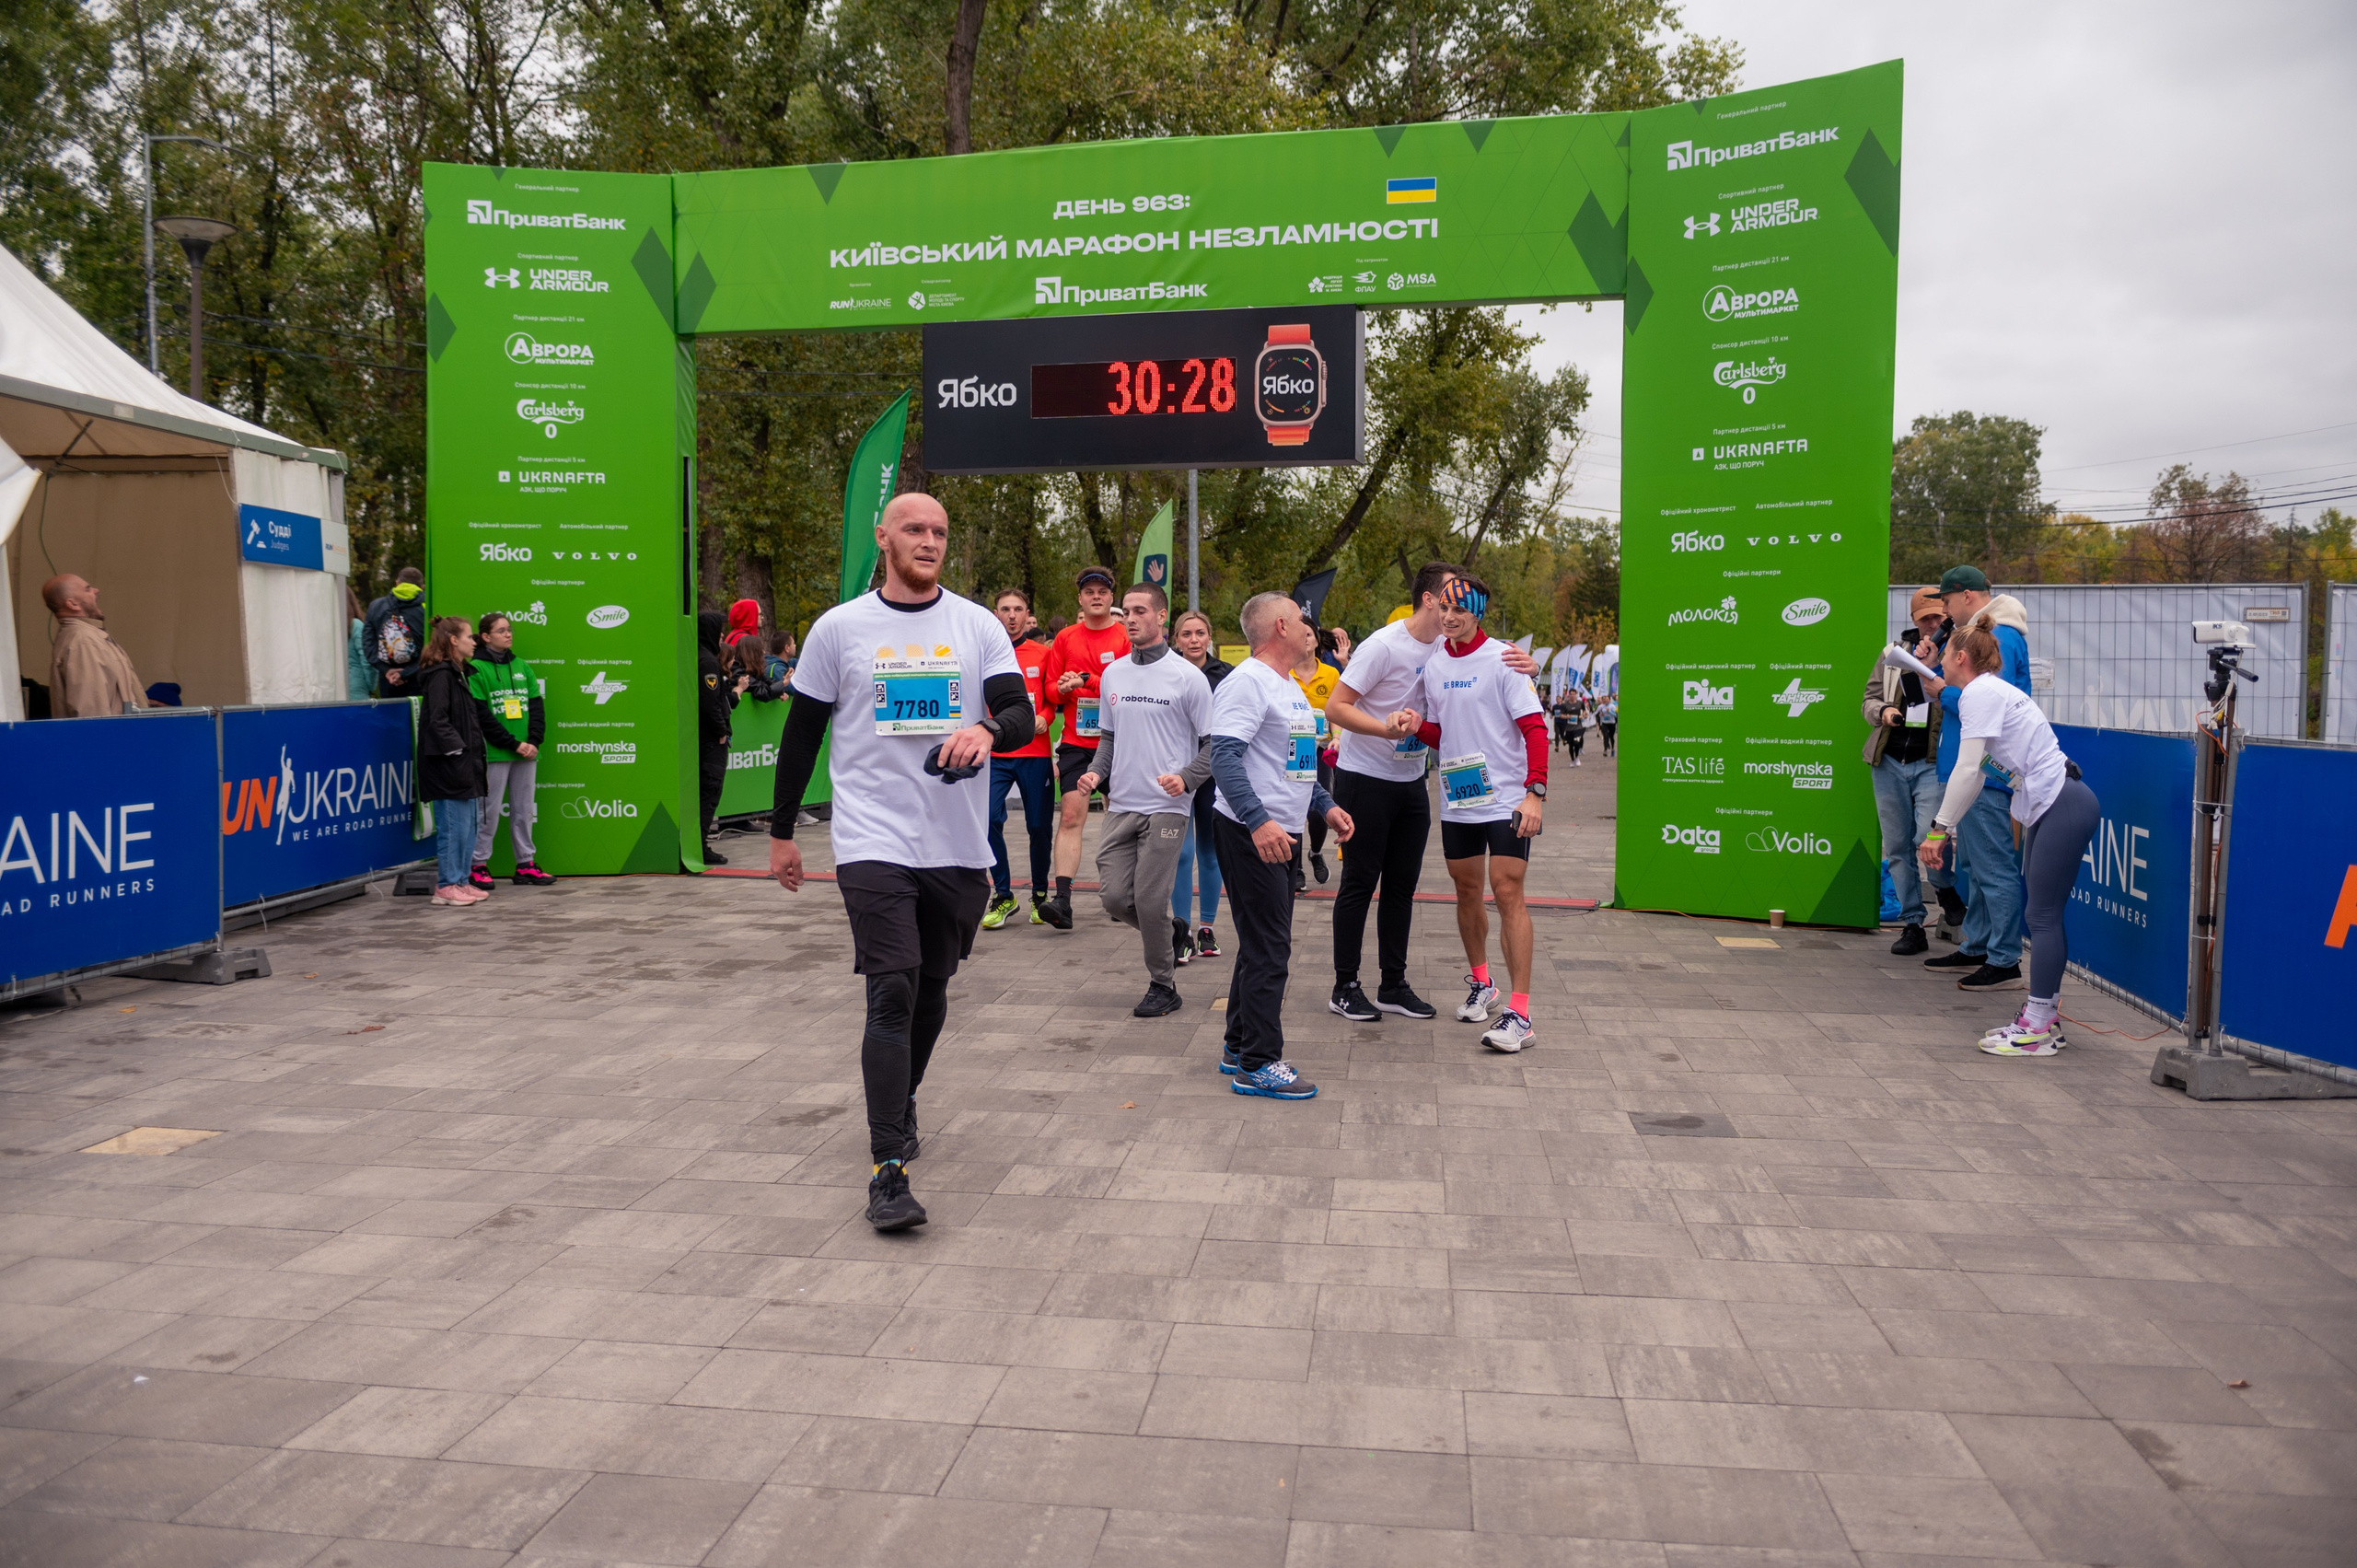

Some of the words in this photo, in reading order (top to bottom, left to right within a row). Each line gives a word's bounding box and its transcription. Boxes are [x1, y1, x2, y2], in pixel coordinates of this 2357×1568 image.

[1716, 106, 1759, 120] Генеральний
[1759, 101, 1786, 114] партнер
[1695, 127, 1840, 168] ПриватБанк
[516, 183, 552, 192] Генеральний
[1718, 188, 1757, 199] Спортивний
[1758, 184, 1784, 194] партнер
[1053, 198, 1125, 220] ДЕНЬ
[1132, 193, 1190, 212] 963:
[1732, 198, 1799, 221] UNDER
[493, 209, 626, 230] ПриватБанк
[1731, 208, 1818, 233] ARMOUR
[830, 235, 1007, 268] КИЇВСЬКИЙ
[1016, 231, 1179, 259] МАРАФОН
[1190, 218, 1438, 250] НЕЗЛАМНОСТІ
[517, 252, 552, 261] Спортивний
[1713, 263, 1738, 272] Партнер
[1740, 258, 1771, 269] дистанції
[529, 269, 592, 281] UNDER
[1407, 273, 1436, 284] MSA
[529, 280, 610, 293] ARMOUR
[1062, 282, 1208, 307] ПриватБанк
[830, 300, 850, 309] RUN
[1709, 287, 1799, 314] АВРОРА
[513, 314, 538, 322] Партнер
[1734, 304, 1799, 319] МУЛЬТИМАРКЕТ
[512, 338, 594, 358] АВРОРА
[1739, 337, 1770, 348] дистанції
[535, 357, 595, 366] МУЛЬТИМАРКЕТ
[1713, 357, 1786, 387] Carlsberg
[515, 382, 540, 390] Спонсор
[937, 376, 1016, 409] Ябко
[1107, 357, 1236, 414] 30:28
[1263, 374, 1314, 395] Ябко
[1743, 387, 1756, 404] 0
[517, 399, 585, 424] Carlsberg
[545, 424, 557, 438] 0
[1713, 427, 1739, 436] Партнер
[1740, 423, 1771, 433] дистанції
[1713, 439, 1807, 459] UKRNAFTA
[1714, 462, 1728, 470] АЗК,
[1743, 460, 1764, 469] ПОРУЧ
[519, 471, 606, 483] UKRNAFTA
[1661, 507, 1691, 516] Офіційний
[1693, 505, 1736, 515] хронометрист
[1755, 500, 1805, 510] Автомобільний
[1806, 499, 1832, 507] партнер
[268, 521, 291, 539] Судді
[1671, 530, 1724, 552] Ябко
[1747, 532, 1841, 546] VOLVO
[481, 543, 532, 562] Ябко
[552, 552, 637, 561] VOLVO
[589, 610, 626, 623] Smile
[1785, 602, 1827, 621] Smile
[1451, 680, 1472, 689] BRAVE
[1121, 695, 1170, 705] robota.ua
[894, 700, 939, 718] 7780
[557, 740, 636, 755] morshynska
[1662, 757, 1695, 774] TAS
[1699, 758, 1724, 774] life
[1744, 761, 1832, 777] morshynska
[1456, 784, 1480, 799] 6920
[1795, 779, 1829, 787] SPORT
[223, 775, 277, 835] UN
[585, 800, 637, 818] Volia
[293, 830, 309, 842] WE
[316, 825, 338, 838] ARE
[344, 818, 374, 832] ROAD
[379, 812, 412, 826] RUNNE
[1161, 829, 1178, 838] EA7
[1662, 825, 1720, 846] Data
[0, 802, 155, 884] AINE
[1772, 830, 1831, 855] Volia
[2082, 817, 2150, 901] AINE
[0, 899, 31, 916] AD
[50, 878, 155, 908] RUNNERS
[2097, 897, 2147, 928] RUNNERS
